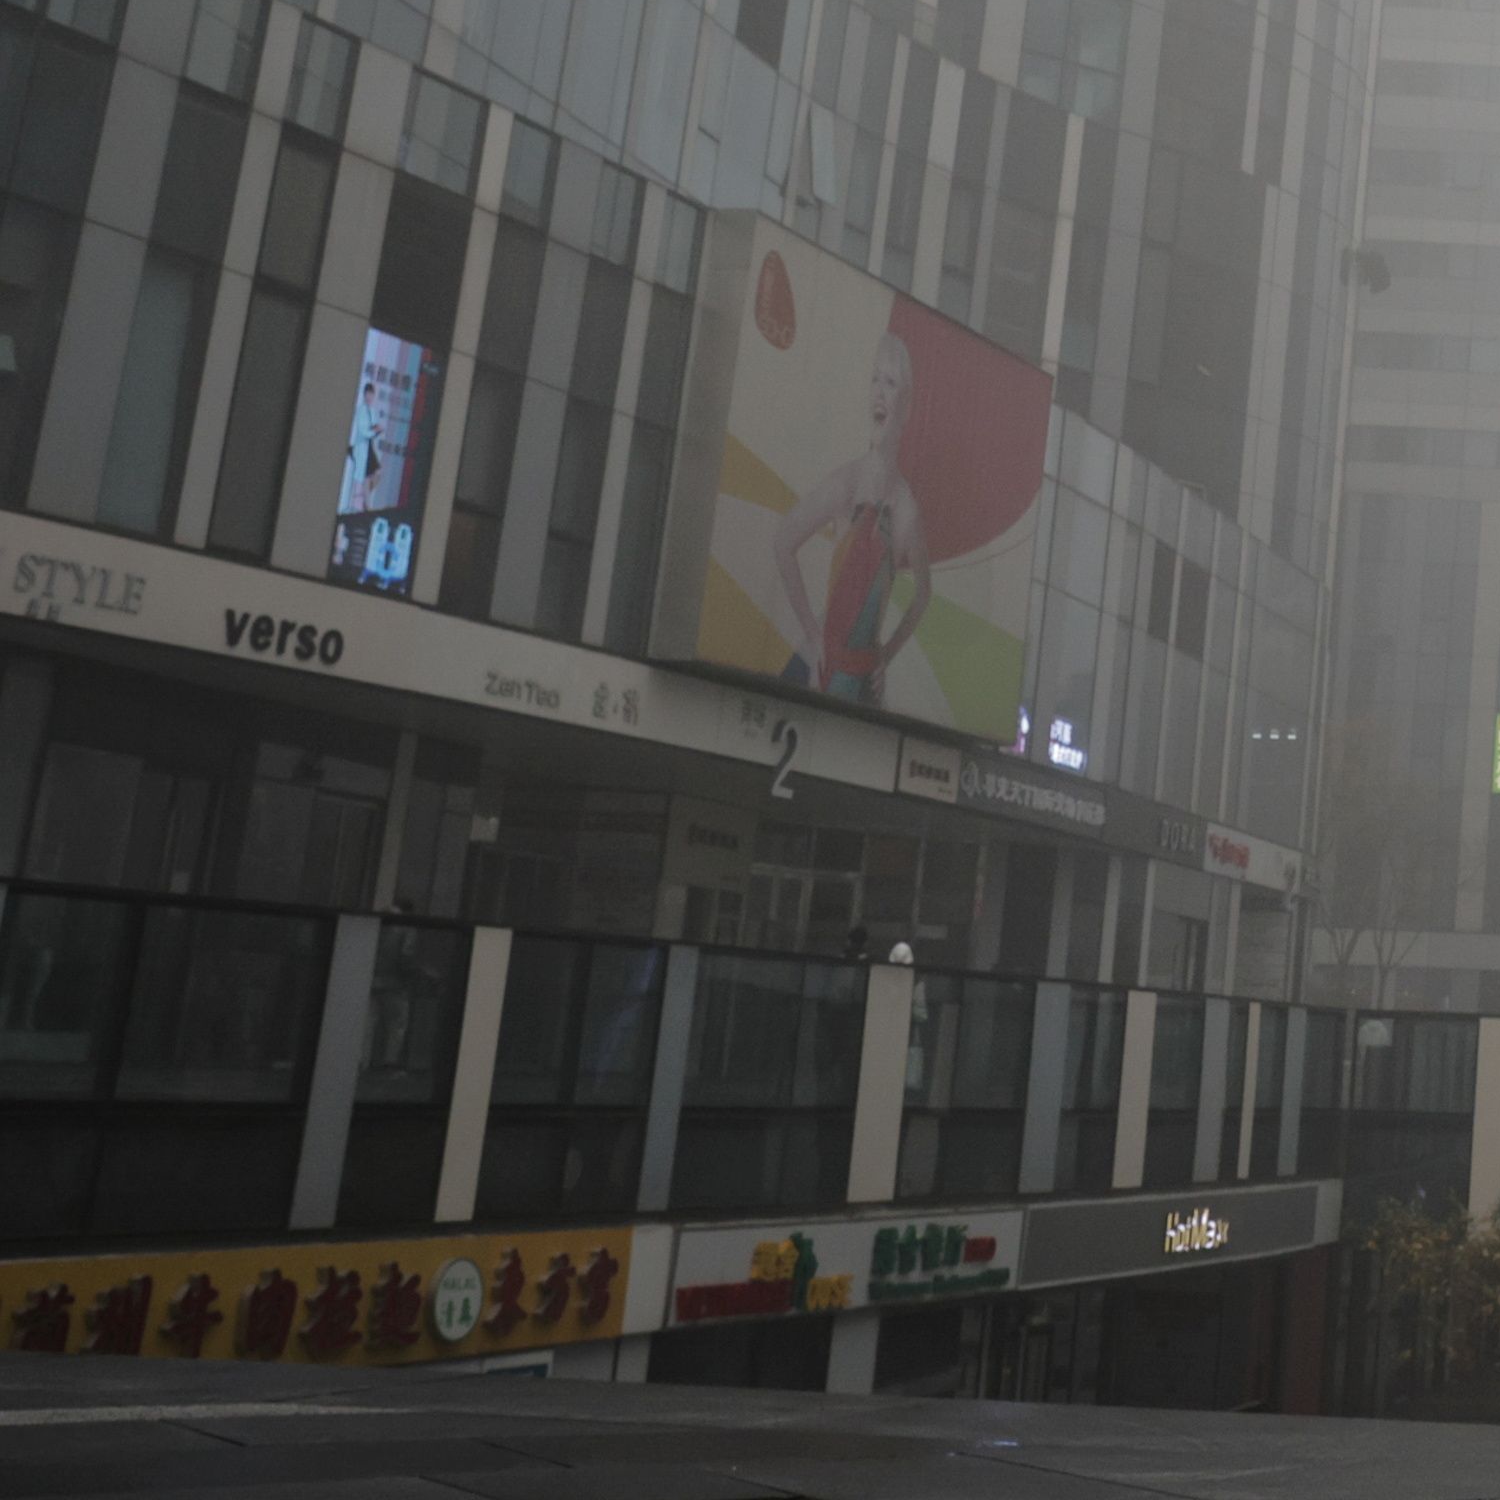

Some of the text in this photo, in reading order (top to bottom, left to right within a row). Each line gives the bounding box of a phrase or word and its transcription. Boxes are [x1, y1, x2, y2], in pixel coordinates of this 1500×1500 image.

[13, 553, 147, 615] STYLE
[224, 608, 344, 665] verso
[771, 719, 800, 799] 2
